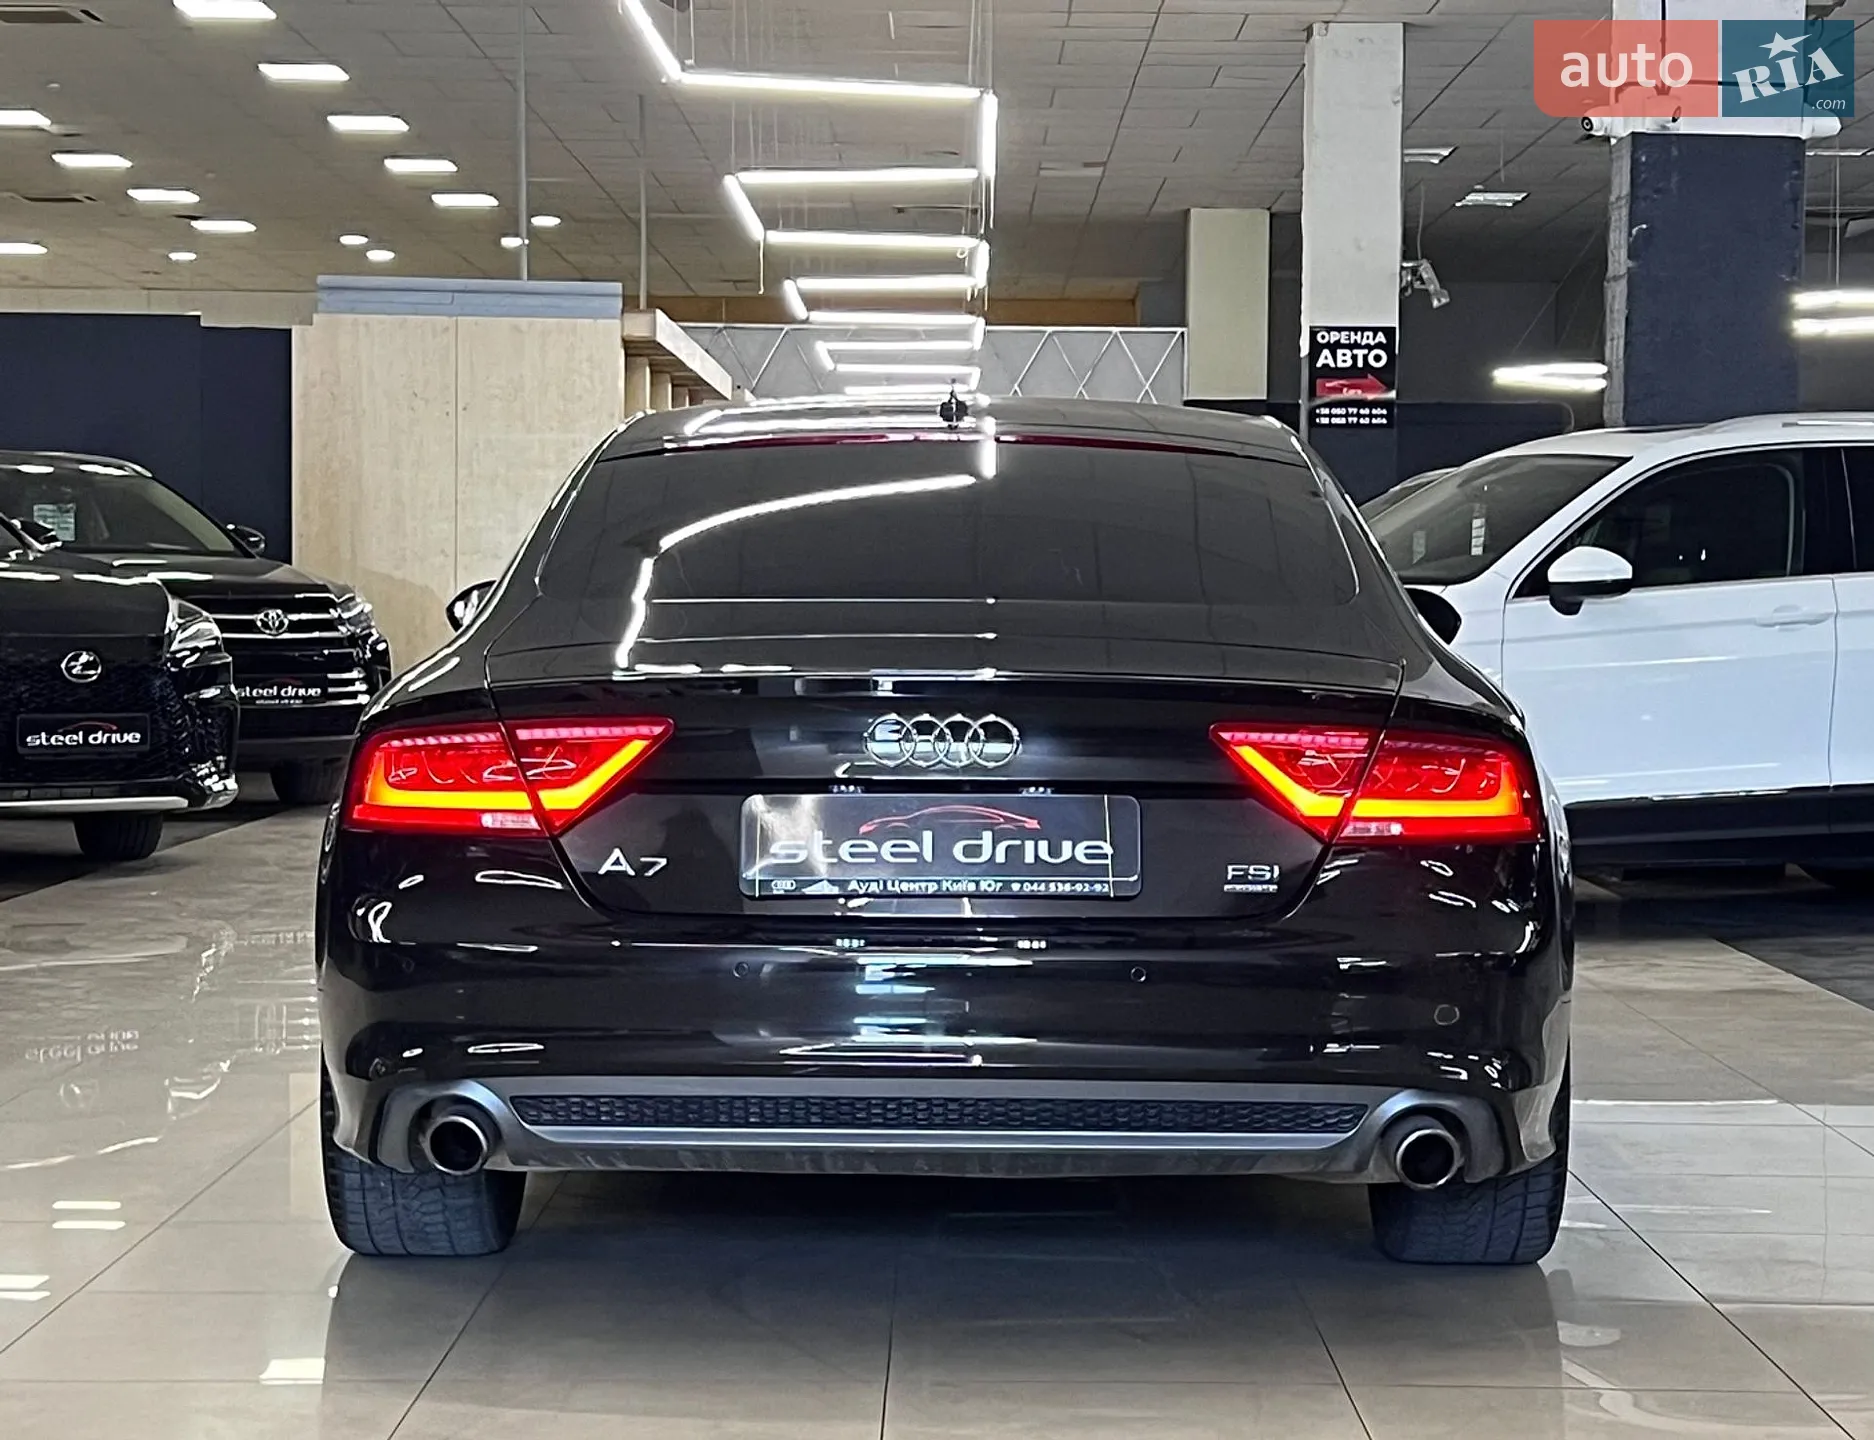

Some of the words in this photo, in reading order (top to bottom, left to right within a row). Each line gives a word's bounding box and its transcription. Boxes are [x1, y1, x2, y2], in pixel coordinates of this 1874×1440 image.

[1316, 331, 1387, 346] ОРЕНДА
[1316, 348, 1388, 368] АВТО
[280, 685, 322, 697] drive
[26, 730, 84, 746] steel
[88, 730, 141, 745] drive
[769, 830, 933, 864] steel
[952, 830, 1113, 864] drive
[598, 847, 668, 877] A7
[1227, 864, 1280, 881] FSI
[887, 880, 938, 894] Центр
